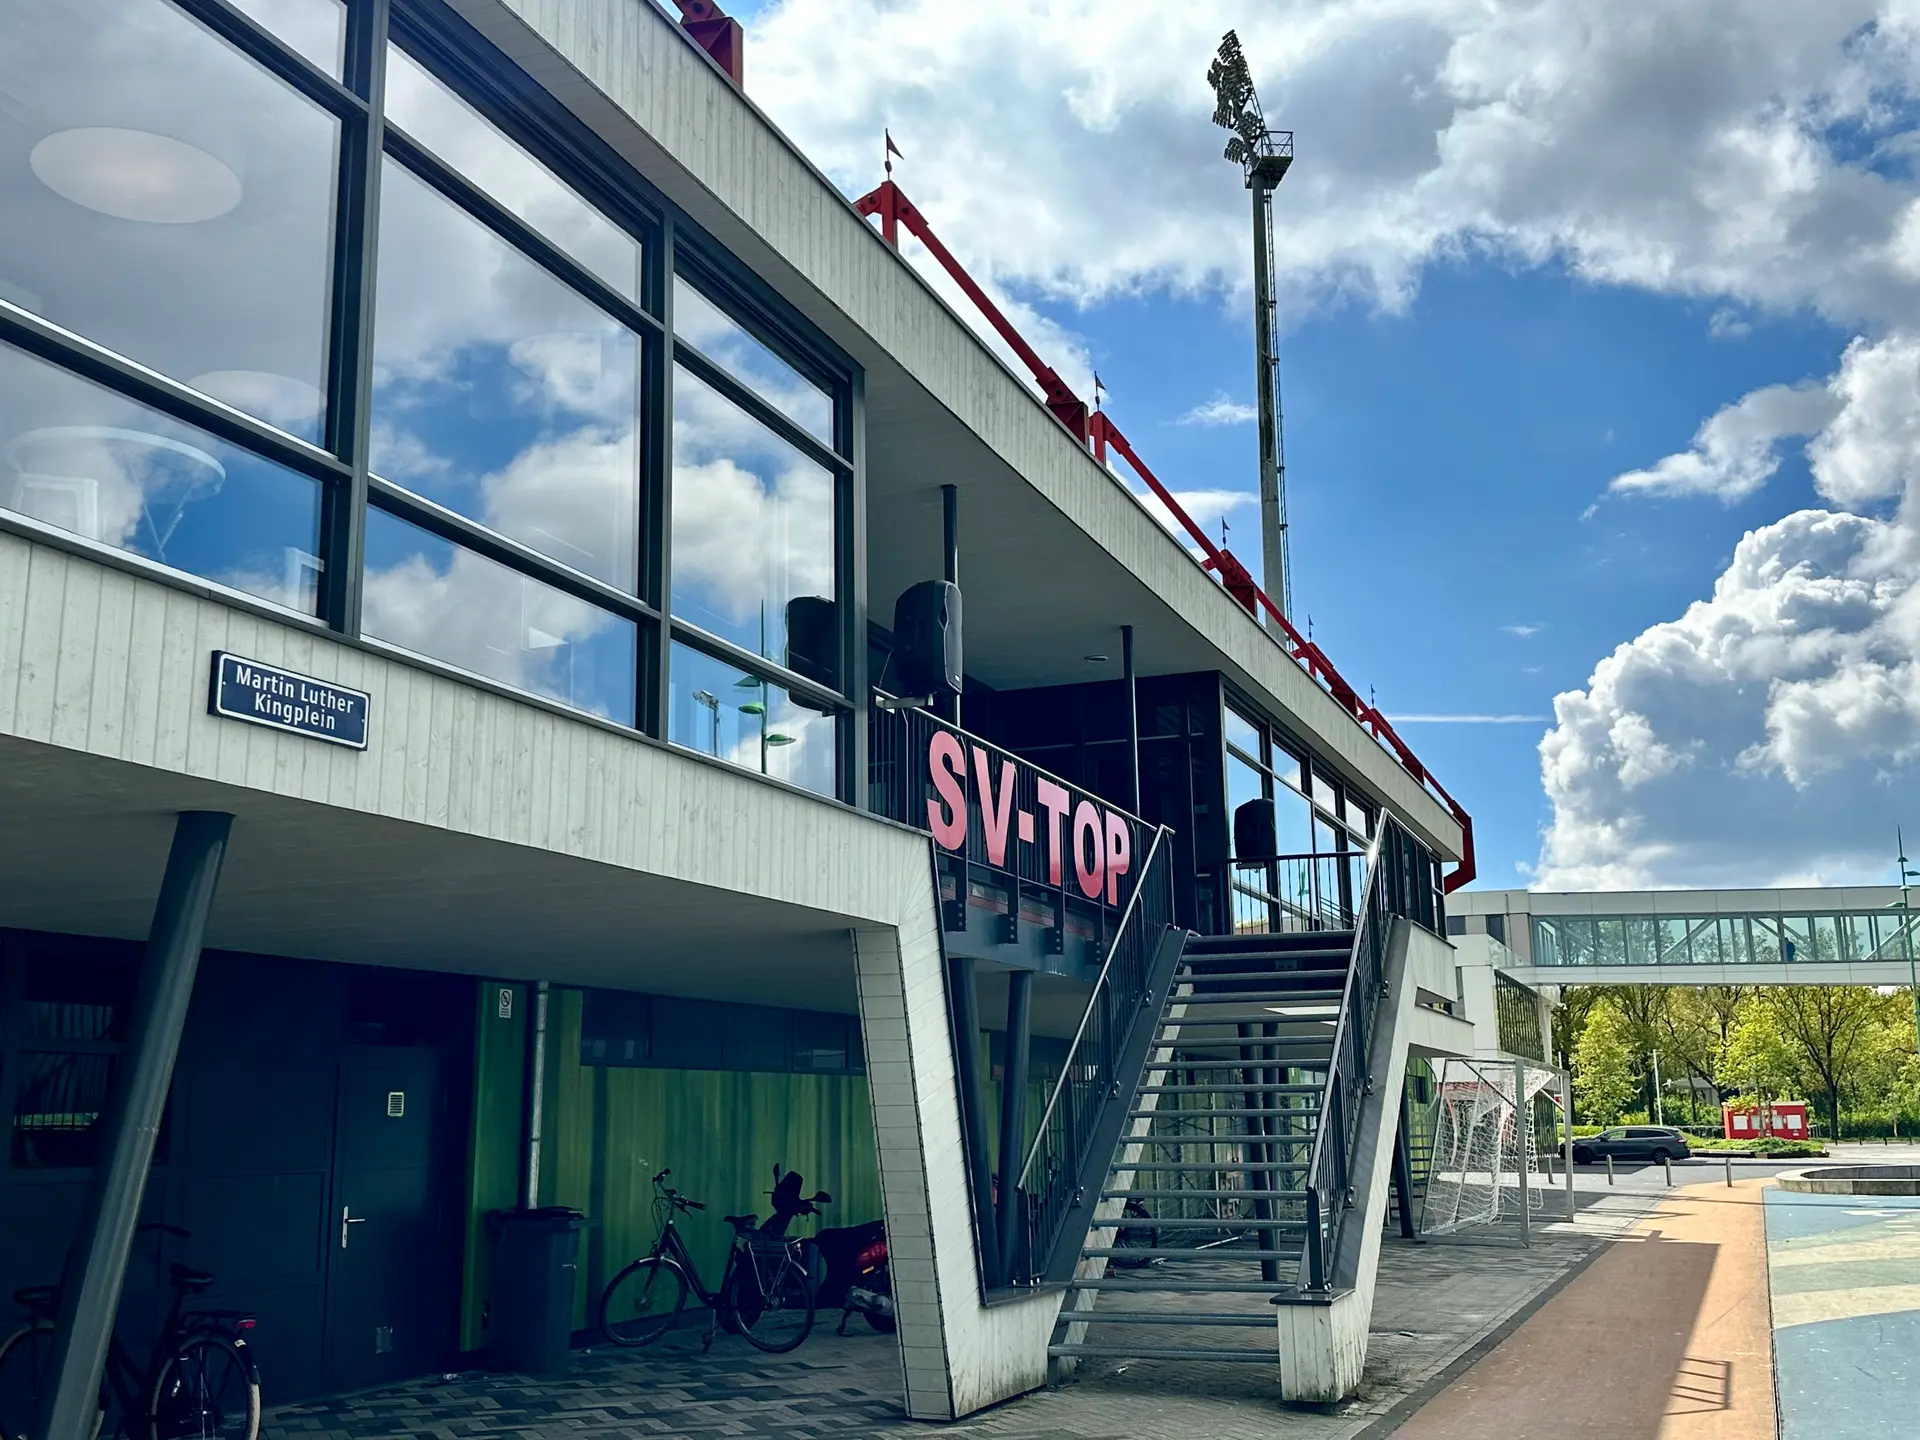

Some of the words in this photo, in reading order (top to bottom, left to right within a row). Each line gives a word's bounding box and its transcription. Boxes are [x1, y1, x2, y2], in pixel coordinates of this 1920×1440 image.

[236, 665, 294, 698] Martin
[301, 683, 354, 713] Luther
[255, 692, 336, 730] Kingplein
[927, 730, 1130, 906] SV-TOP
